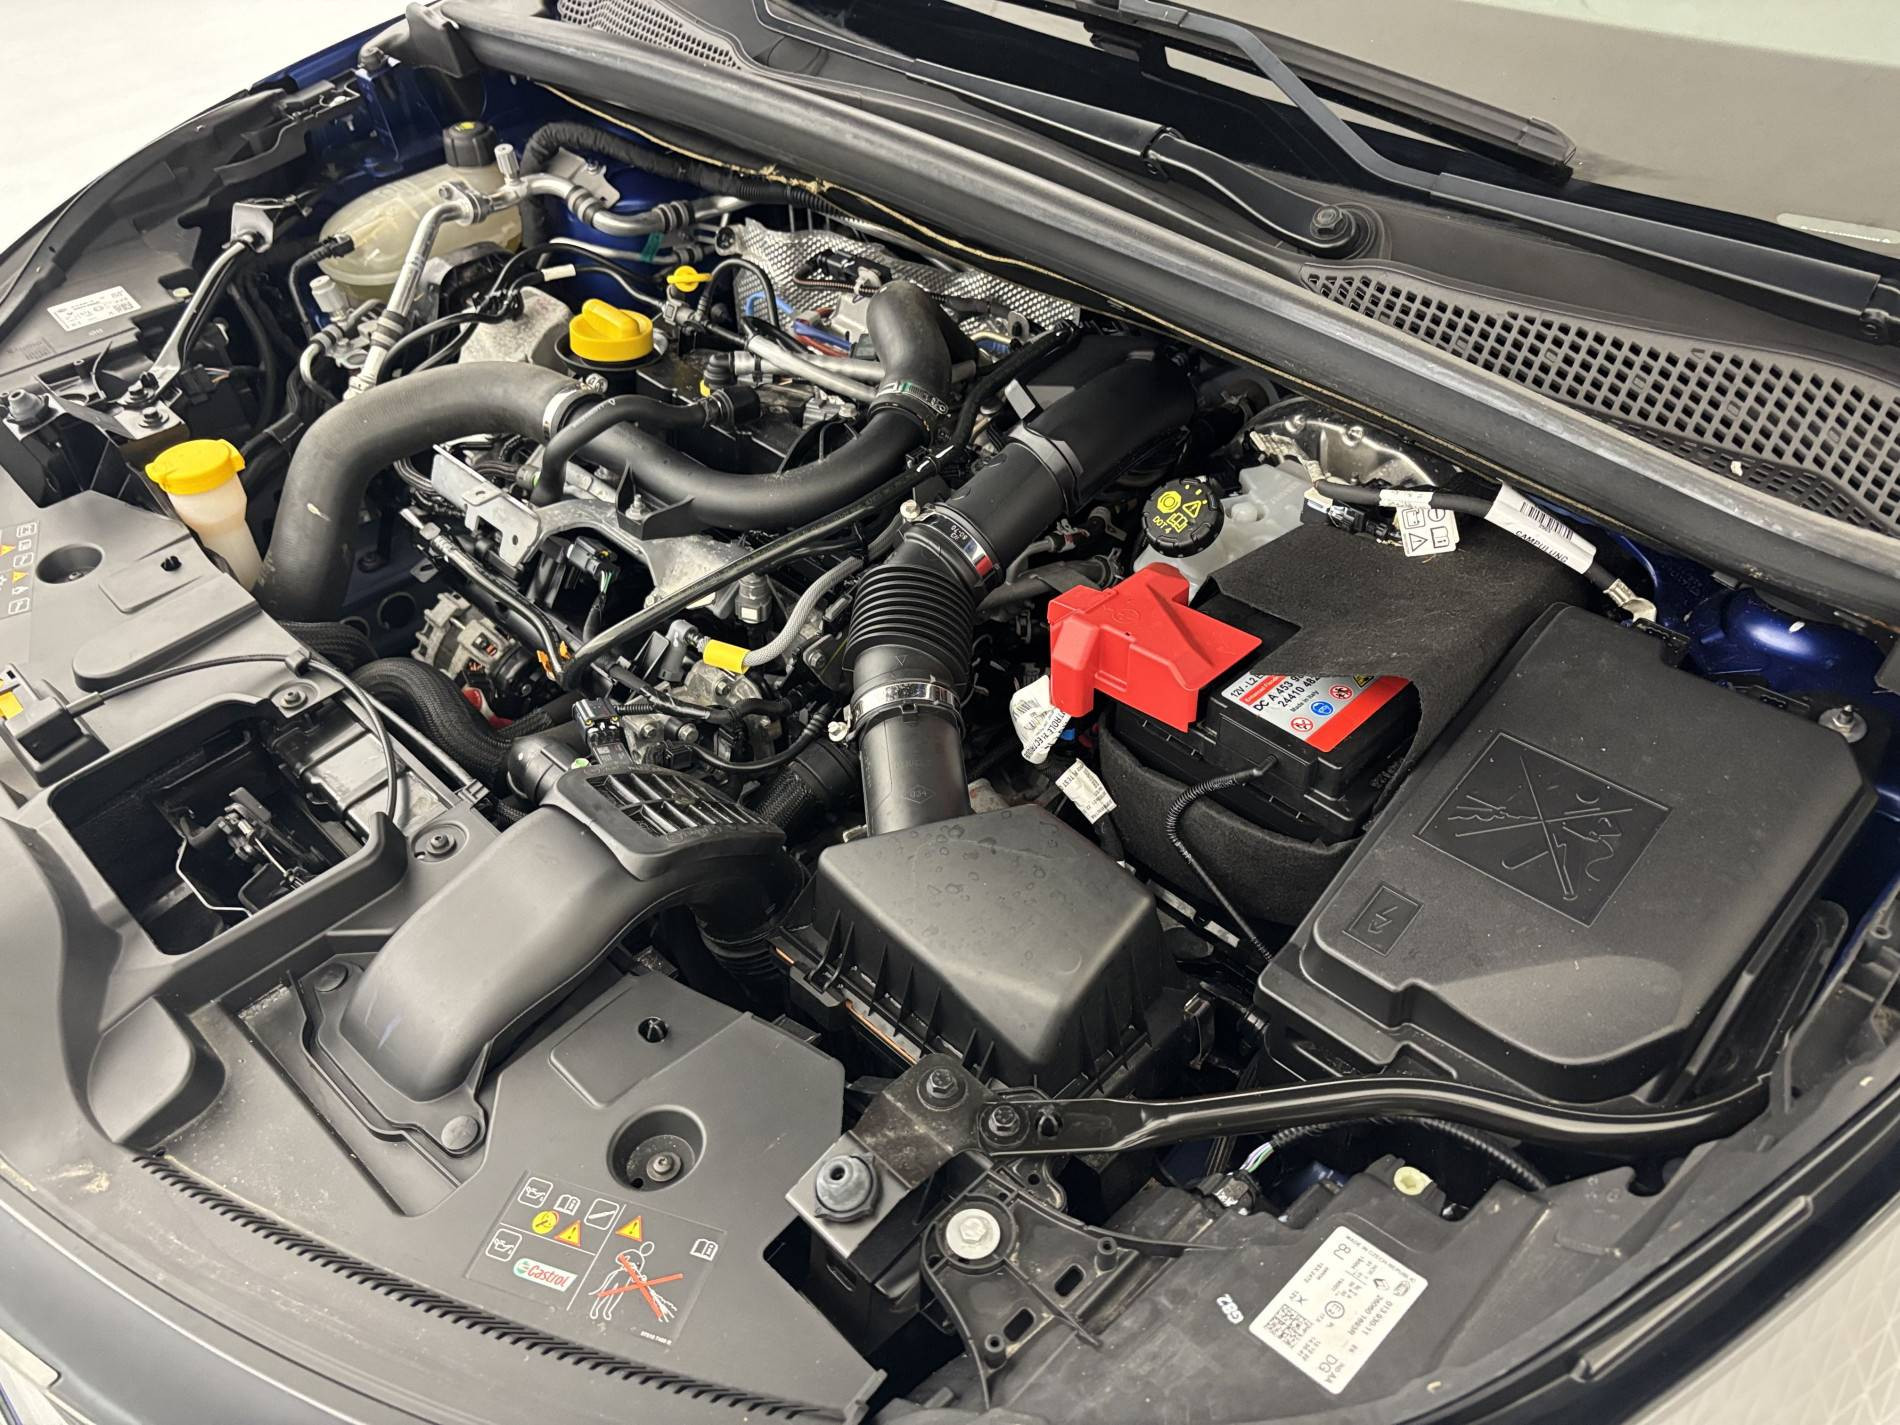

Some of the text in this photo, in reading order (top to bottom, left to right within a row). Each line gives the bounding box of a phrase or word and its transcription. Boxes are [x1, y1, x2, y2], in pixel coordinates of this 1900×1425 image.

[1153, 516, 1168, 528] DOT
[1230, 685, 1245, 698] 12V
[1268, 693, 1278, 701] A
[1276, 680, 1294, 695] 453
[1277, 686, 1305, 707] 24410
[527, 1265, 569, 1287] Castrol
[1318, 1353, 1338, 1374] DG
